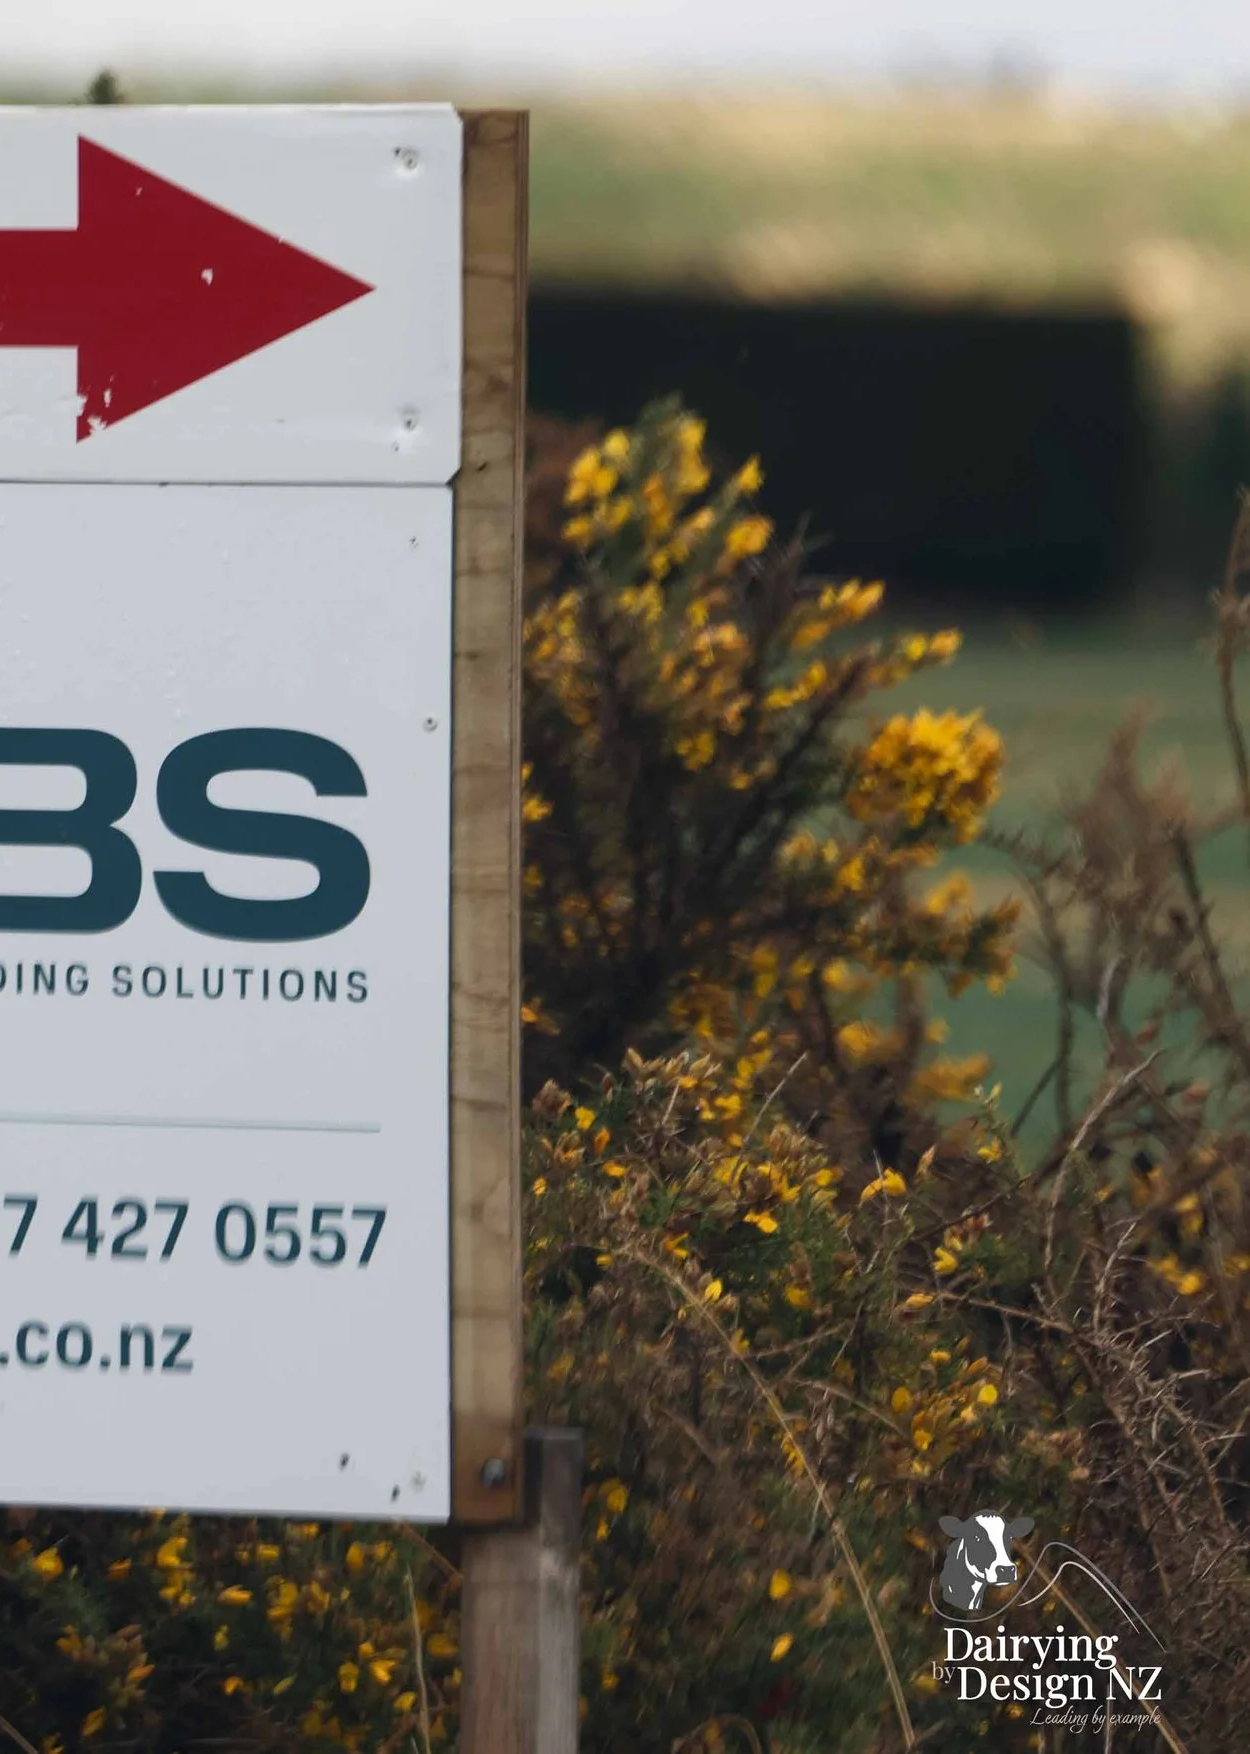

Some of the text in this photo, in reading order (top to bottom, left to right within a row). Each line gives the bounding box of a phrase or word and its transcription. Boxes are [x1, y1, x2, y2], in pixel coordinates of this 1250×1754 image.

[112, 965, 368, 1003] SOLUTIONS
[61, 1198, 189, 1259] 427
[215, 1202, 387, 1267] 0557
